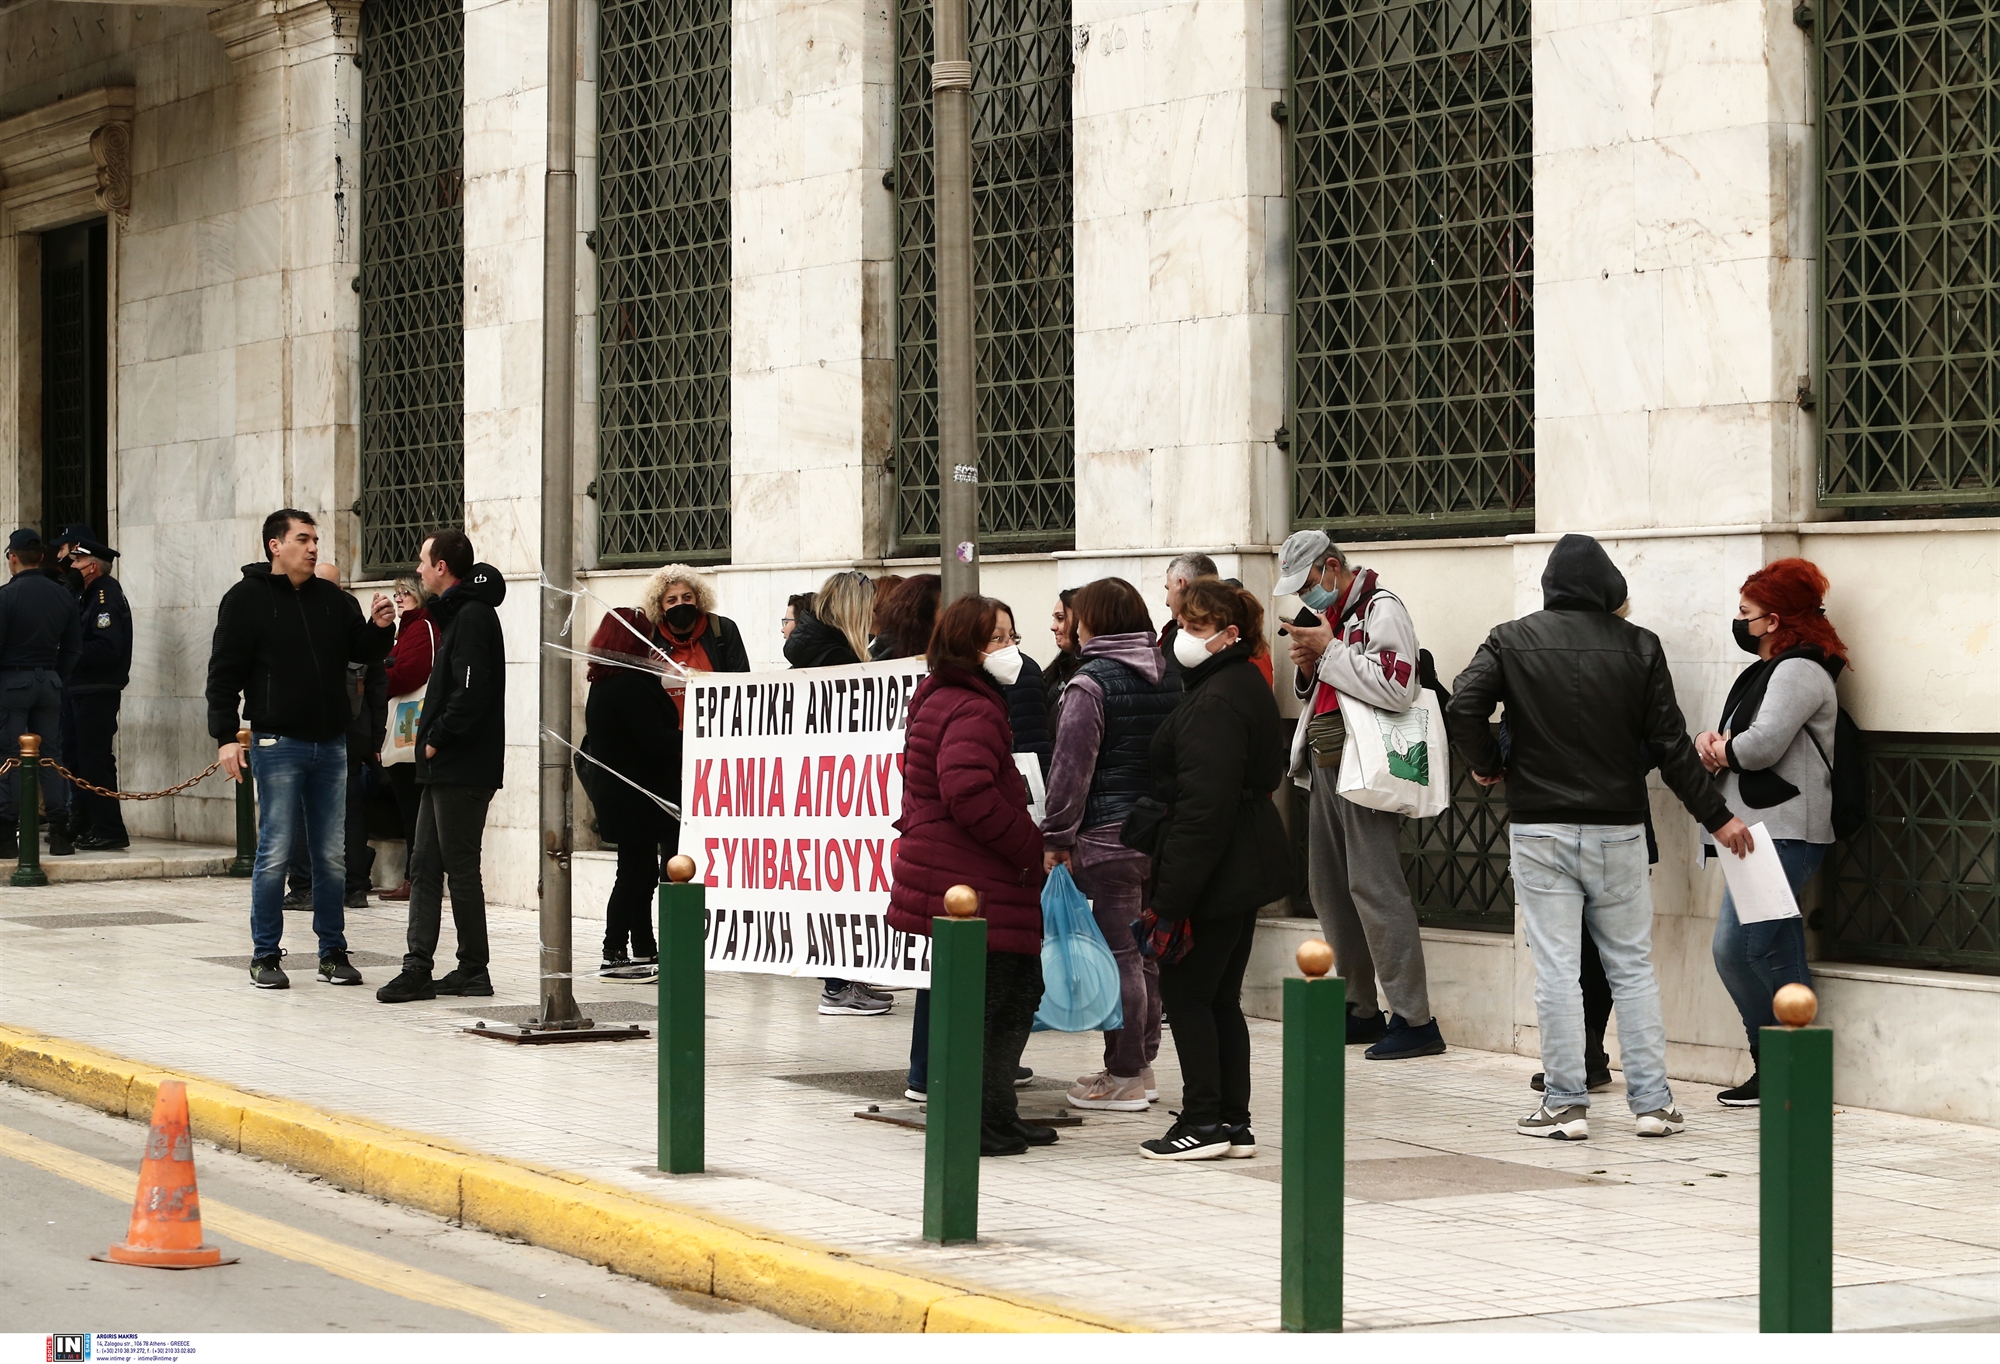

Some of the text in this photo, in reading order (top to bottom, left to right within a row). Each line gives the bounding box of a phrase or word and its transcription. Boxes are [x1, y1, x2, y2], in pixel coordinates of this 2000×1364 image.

[695, 673, 926, 738] ΕΡΓΑΤΙΚΗ ΑΝΤΕΠΙΘΕ
[692, 753, 905, 818] ΚΑΜΙΑ ΑΠΟΛΥ
